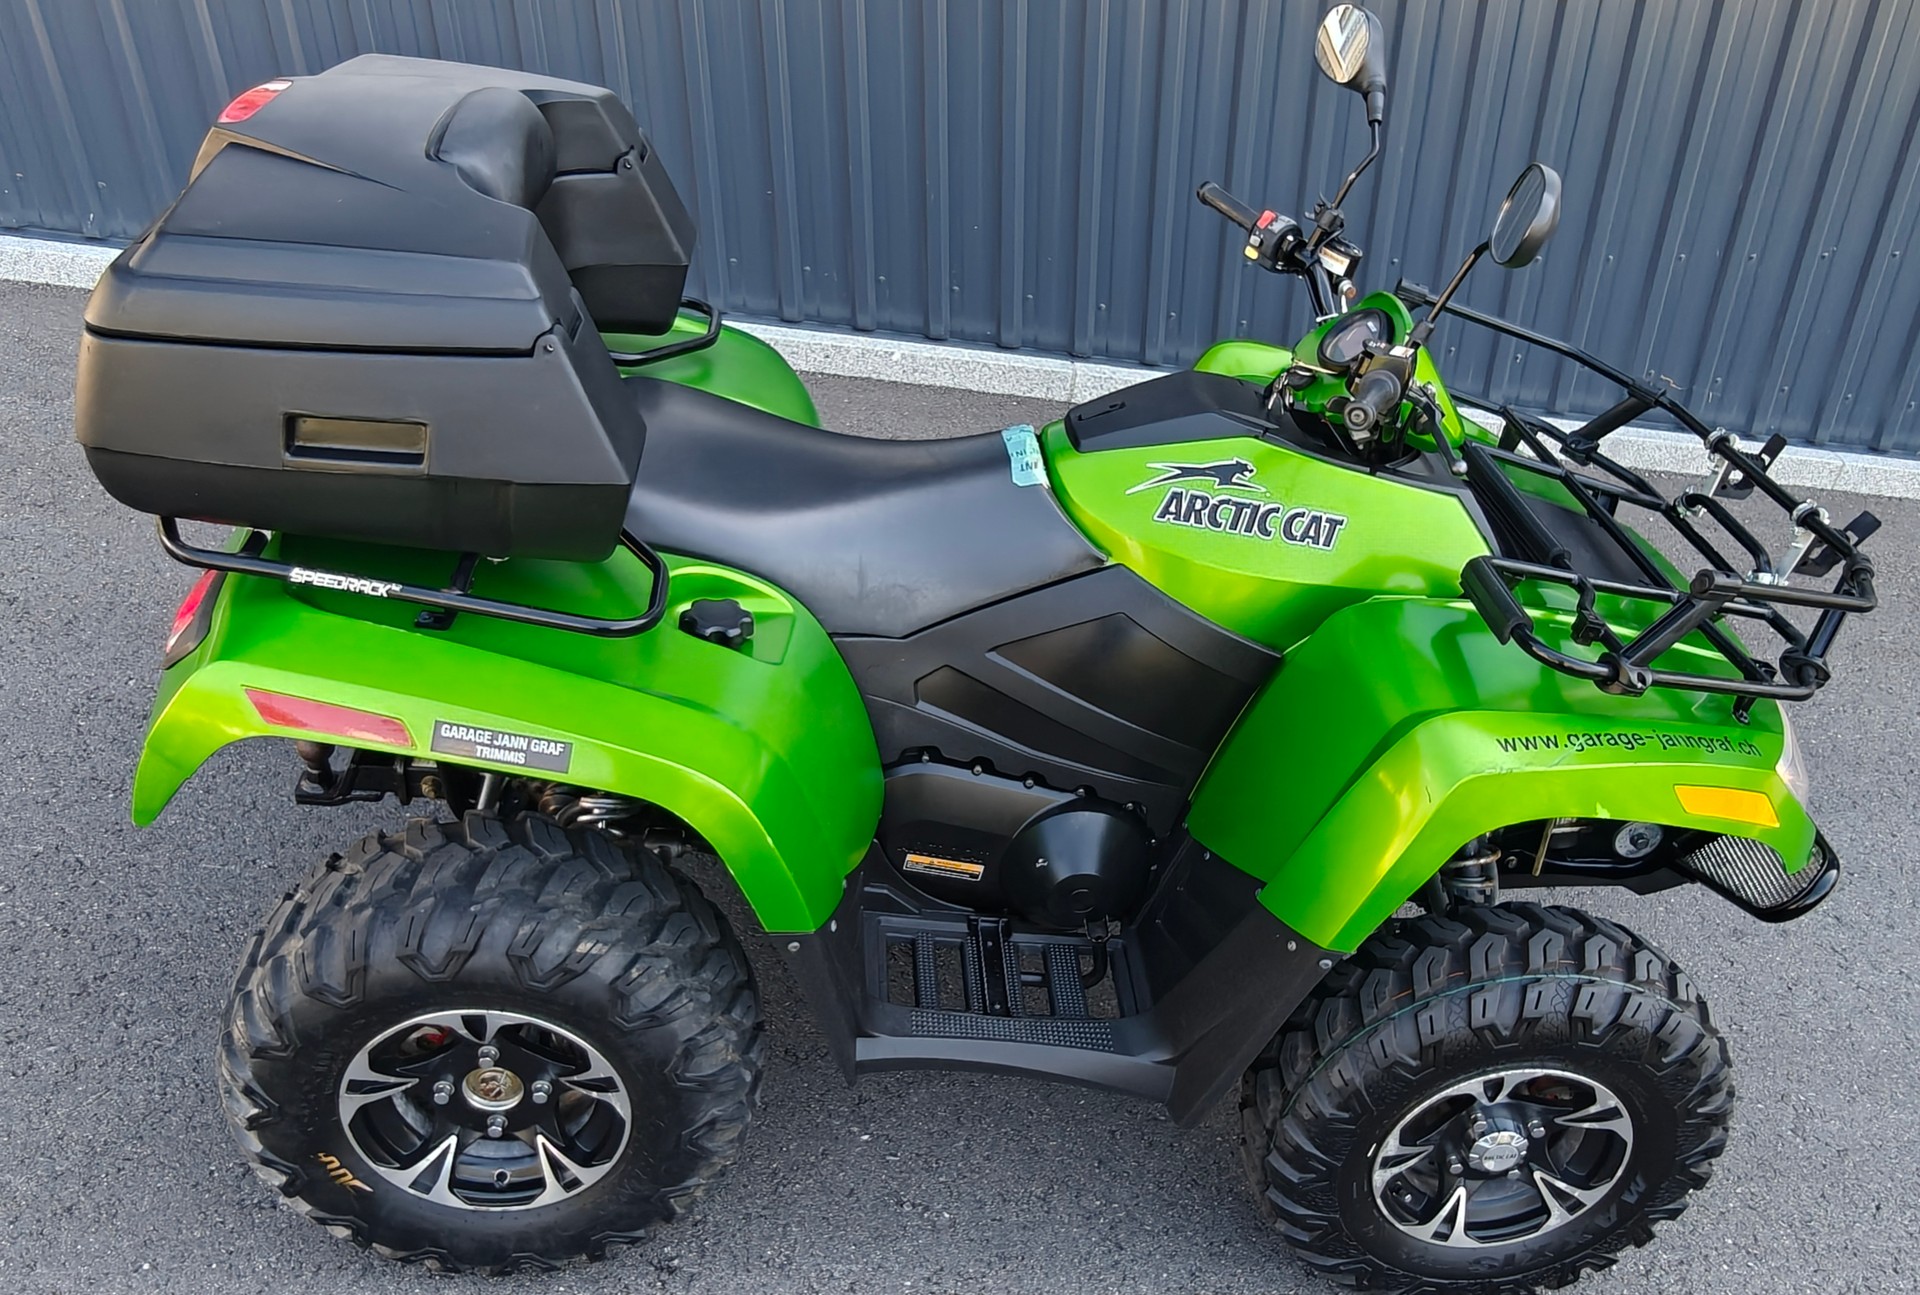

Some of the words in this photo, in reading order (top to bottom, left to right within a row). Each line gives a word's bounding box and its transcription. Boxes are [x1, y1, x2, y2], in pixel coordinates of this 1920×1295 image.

[1155, 488, 1283, 540] ARCTIC
[1281, 507, 1347, 549] CAT
[289, 567, 390, 597] SPEEDRACK
[441, 723, 493, 744] GARAGE
[494, 733, 529, 750] JANN
[530, 738, 564, 756] GRAF
[475, 745, 526, 764] TRIMMIS
